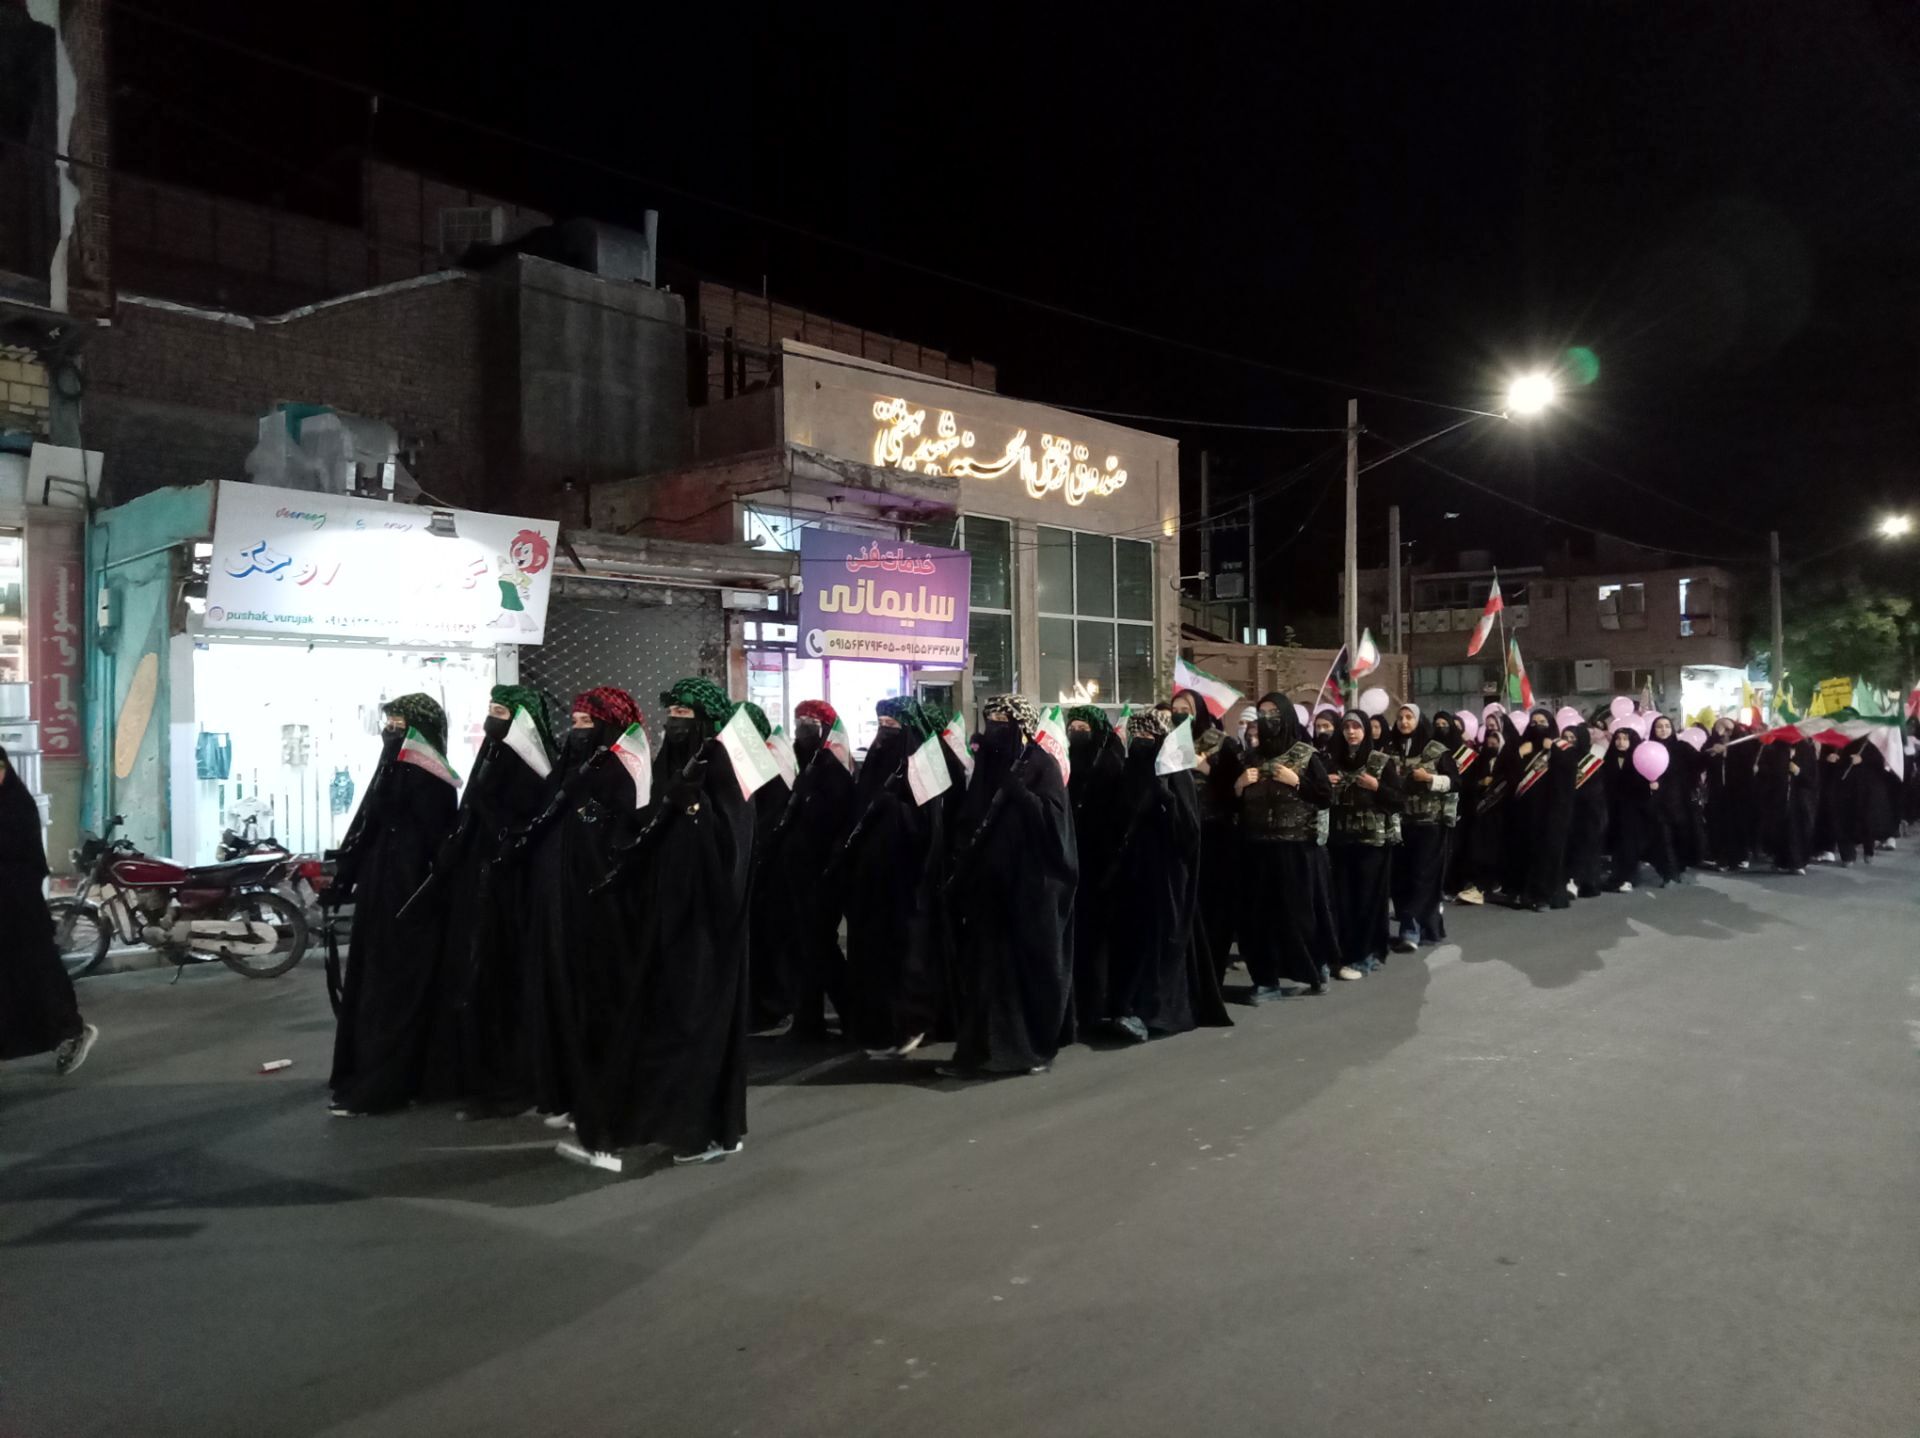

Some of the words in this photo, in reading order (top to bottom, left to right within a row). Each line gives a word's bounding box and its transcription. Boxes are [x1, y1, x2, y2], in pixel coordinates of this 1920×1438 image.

[846, 540, 882, 573] فنی
[882, 548, 936, 574] خدمات
[226, 610, 314, 626] pushak_vurujak
[820, 580, 956, 628] سلیمانی
[43, 670, 77, 750] نوزاد
